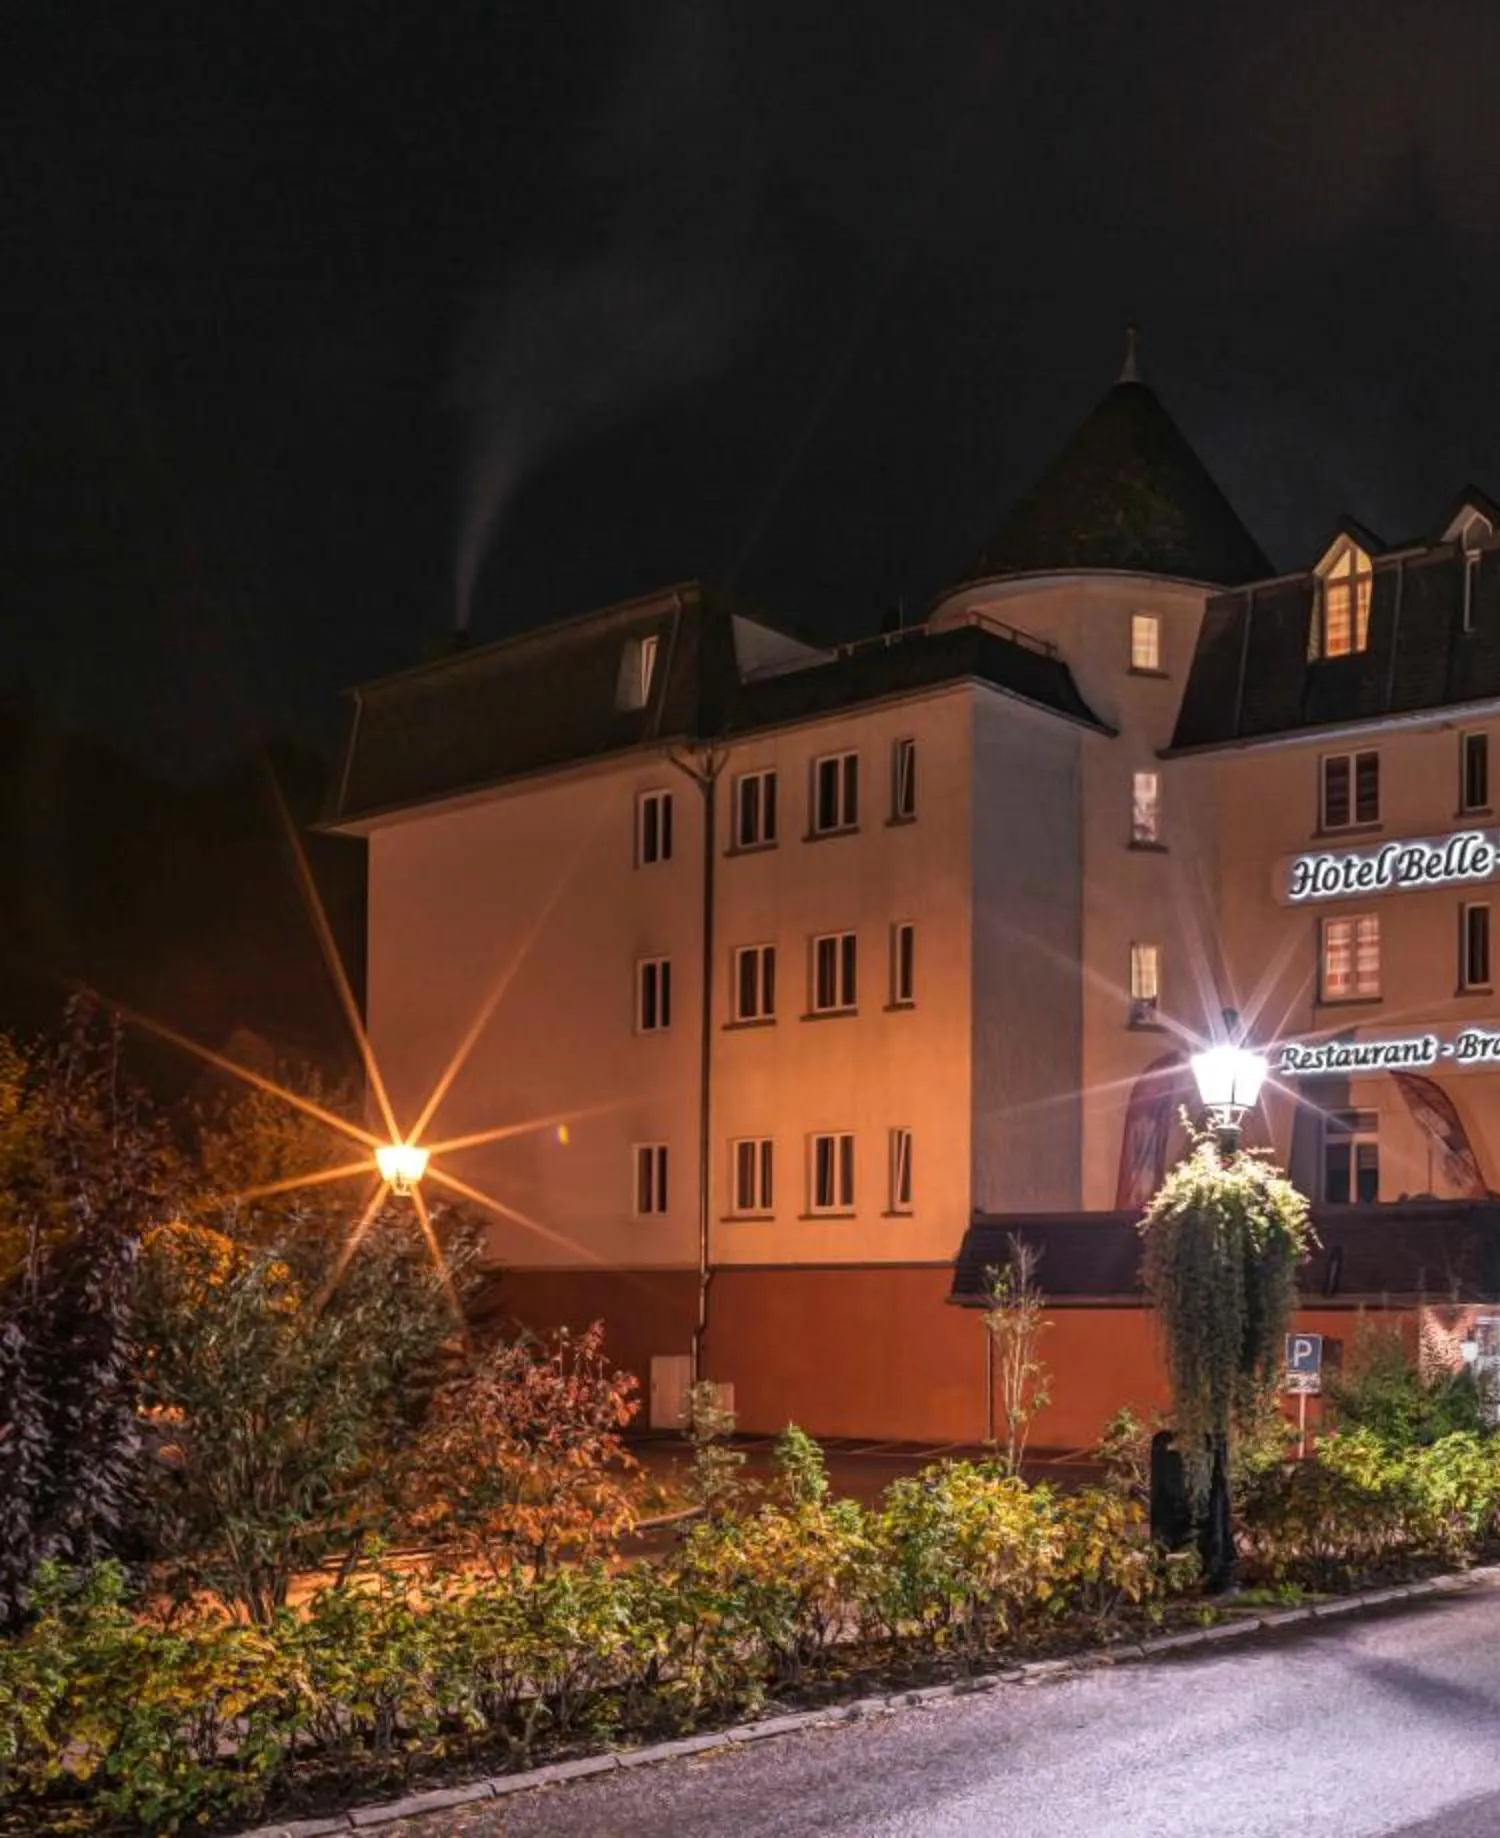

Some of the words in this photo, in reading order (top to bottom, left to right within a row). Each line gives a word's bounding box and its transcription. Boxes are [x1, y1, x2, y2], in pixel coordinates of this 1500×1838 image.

[1289, 845, 1396, 896] Hotel
[1281, 1036, 1434, 1071] Restaurant
[1293, 1339, 1312, 1367] P
